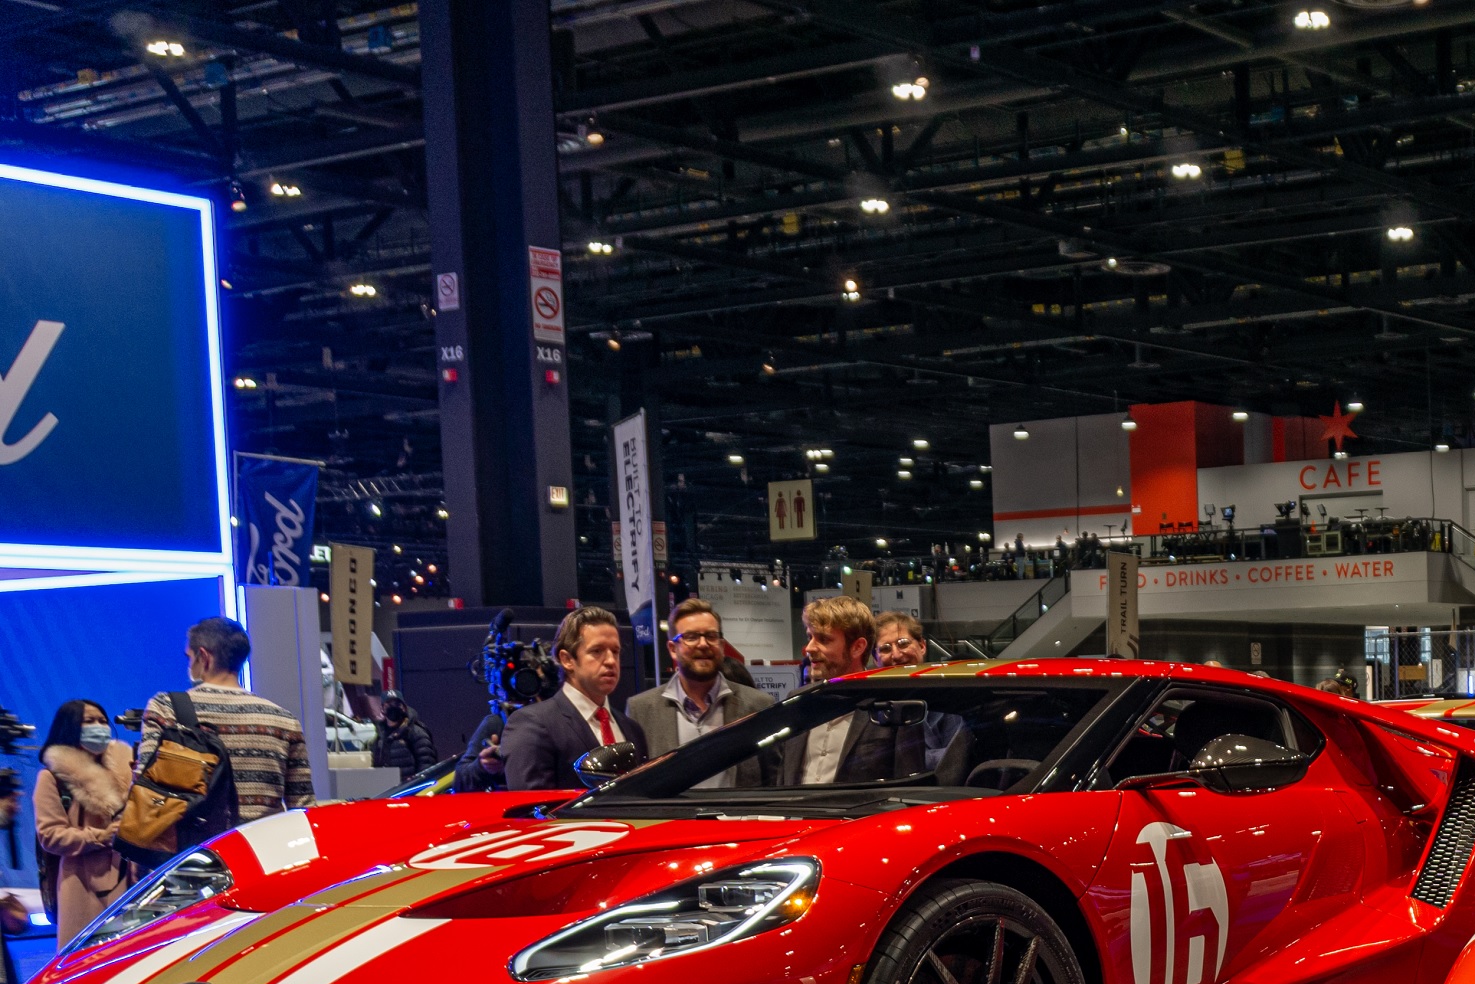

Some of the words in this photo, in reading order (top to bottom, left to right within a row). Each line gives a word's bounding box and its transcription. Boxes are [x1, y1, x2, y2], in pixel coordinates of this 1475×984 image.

[441, 345, 464, 361] X16
[536, 346, 561, 363] X16
[630, 437, 641, 497] BUILT
[1300, 461, 1381, 490] CAFE
[551, 487, 565, 500] EXIT
[622, 441, 639, 593] ELECTRIFY
[1100, 571, 1146, 589] FD
[1166, 568, 1228, 587] DRINKS
[1248, 564, 1315, 583] COFFEE
[1335, 560, 1394, 578] WATER
[349, 557, 357, 675] BRONCO
